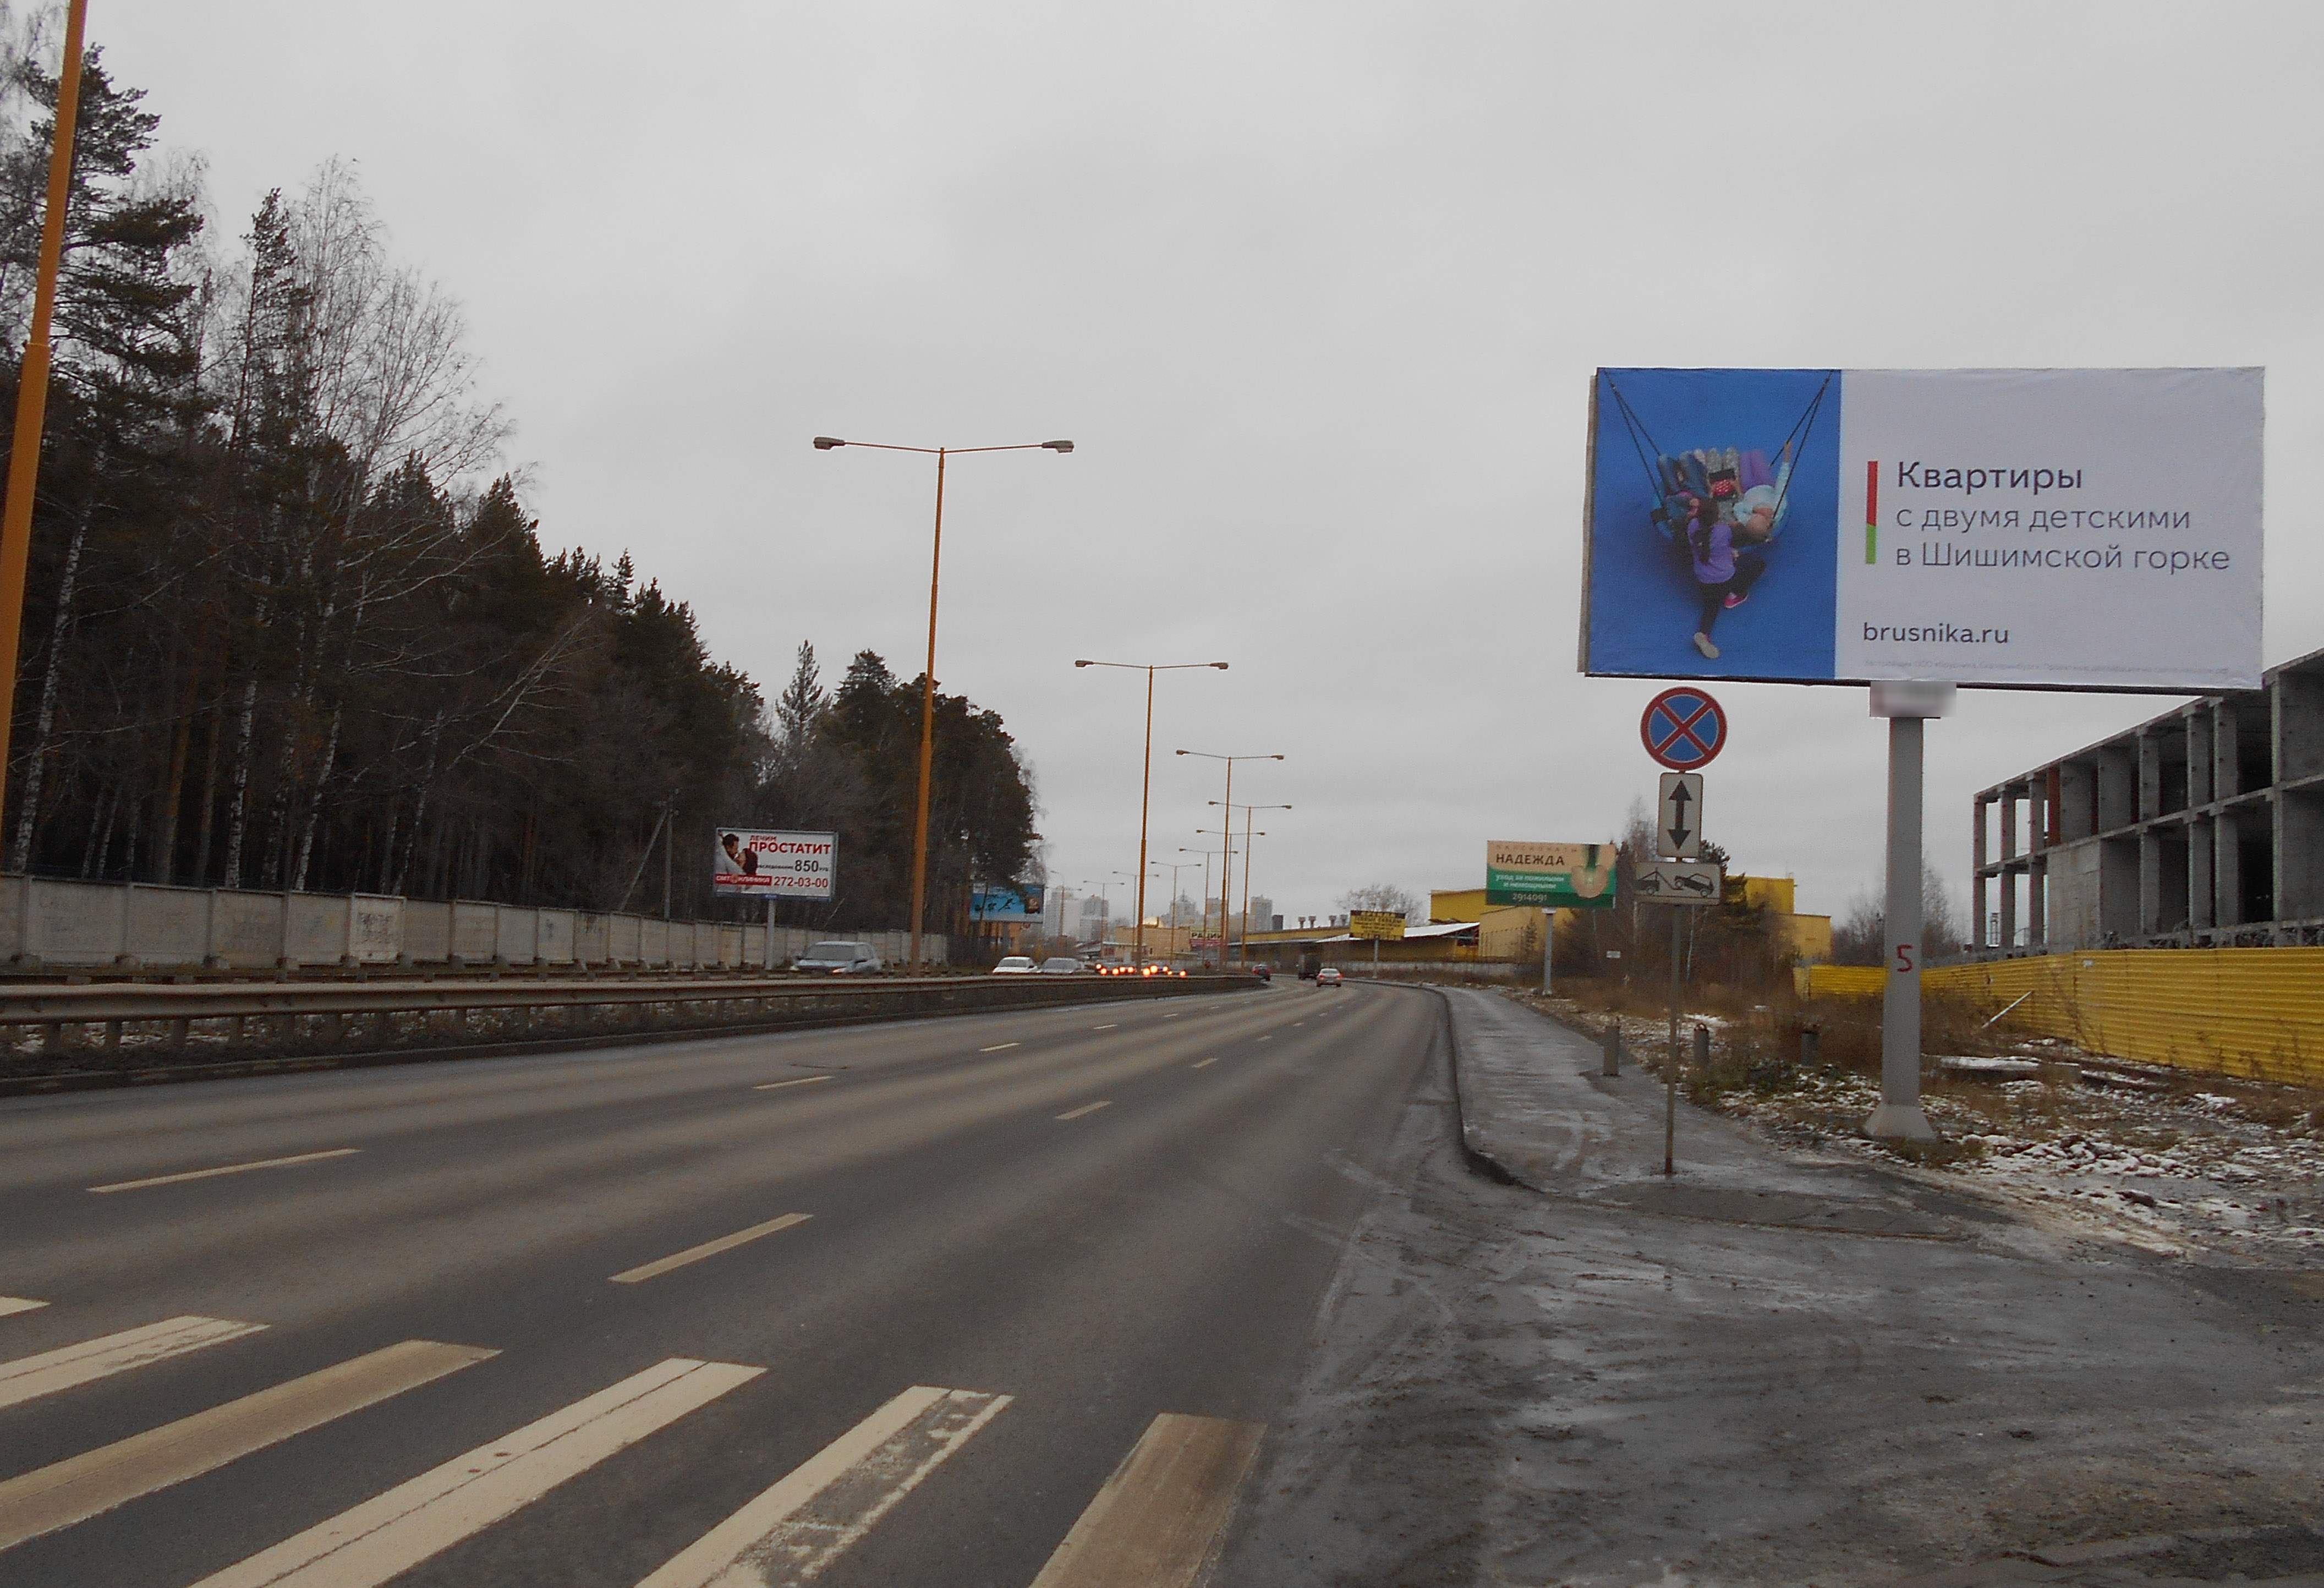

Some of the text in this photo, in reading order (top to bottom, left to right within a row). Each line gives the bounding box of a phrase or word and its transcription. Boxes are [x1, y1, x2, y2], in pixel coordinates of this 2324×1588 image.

[1897, 461, 2082, 494] Квартиры
[1896, 508, 2190, 534] с двумя детскими
[1896, 541, 2231, 576] в Шишимской горке
[1863, 621, 2009, 645] brusnika.ru
[749, 842, 831, 855] ПРОСТАТИТ
[794, 859, 819, 873] 850
[1496, 853, 1565, 866] НАДЕЖДА
[774, 877, 828, 888] 272-03-00
[1512, 892, 1547, 902] 2914091
[1897, 944, 1914, 973] 5
